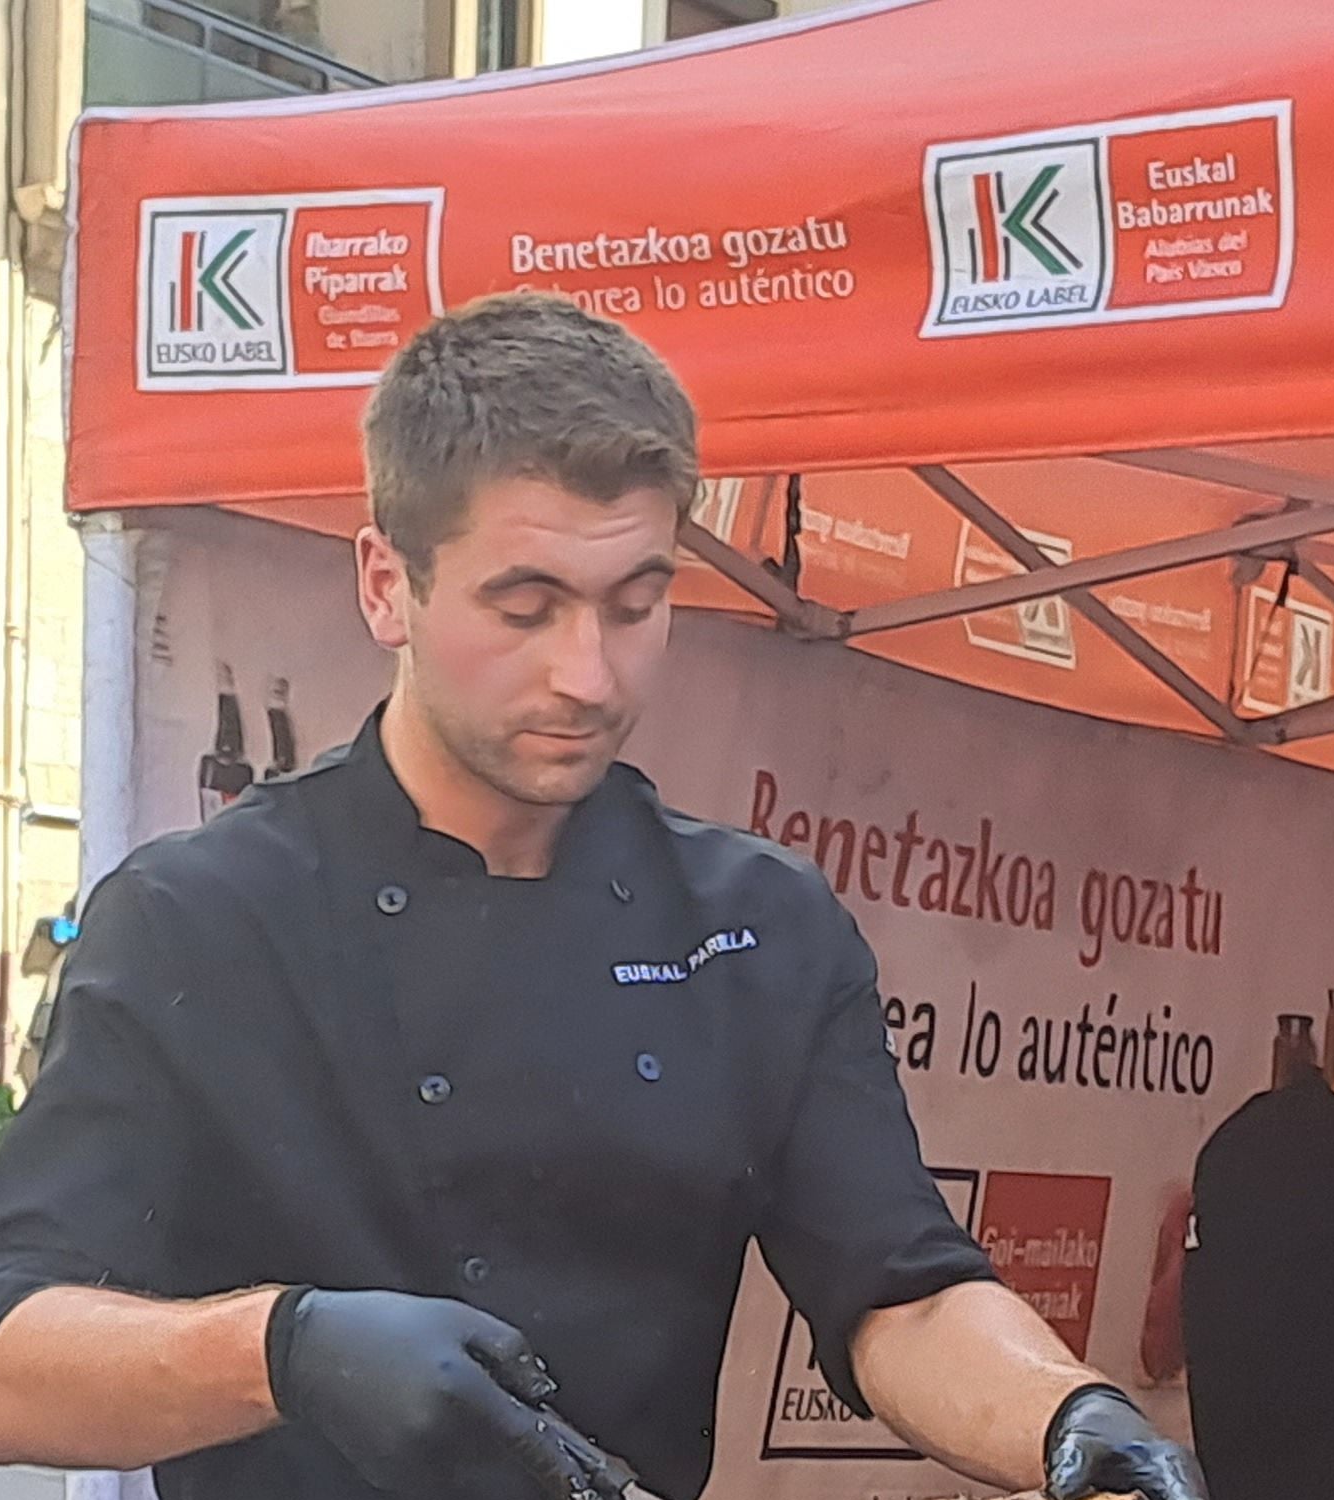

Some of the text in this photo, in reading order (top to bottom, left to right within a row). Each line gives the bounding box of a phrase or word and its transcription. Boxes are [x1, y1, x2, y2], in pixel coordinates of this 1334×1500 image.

[1147, 153, 1236, 190] Euskal
[1116, 187, 1274, 231] Babarrunak
[510, 215, 849, 275] Benetazkoa gozatu
[305, 263, 409, 302] Piparrak
[653, 274, 687, 311] lo
[698, 263, 855, 309] auténtico
[950, 285, 1088, 316] EUSKO LABEL
[750, 769, 1224, 968] Benetazkoa gozatu
[613, 963, 688, 983] EUSKAL
[959, 980, 1002, 1078] lo
[1017, 993, 1214, 1096] auténtico
